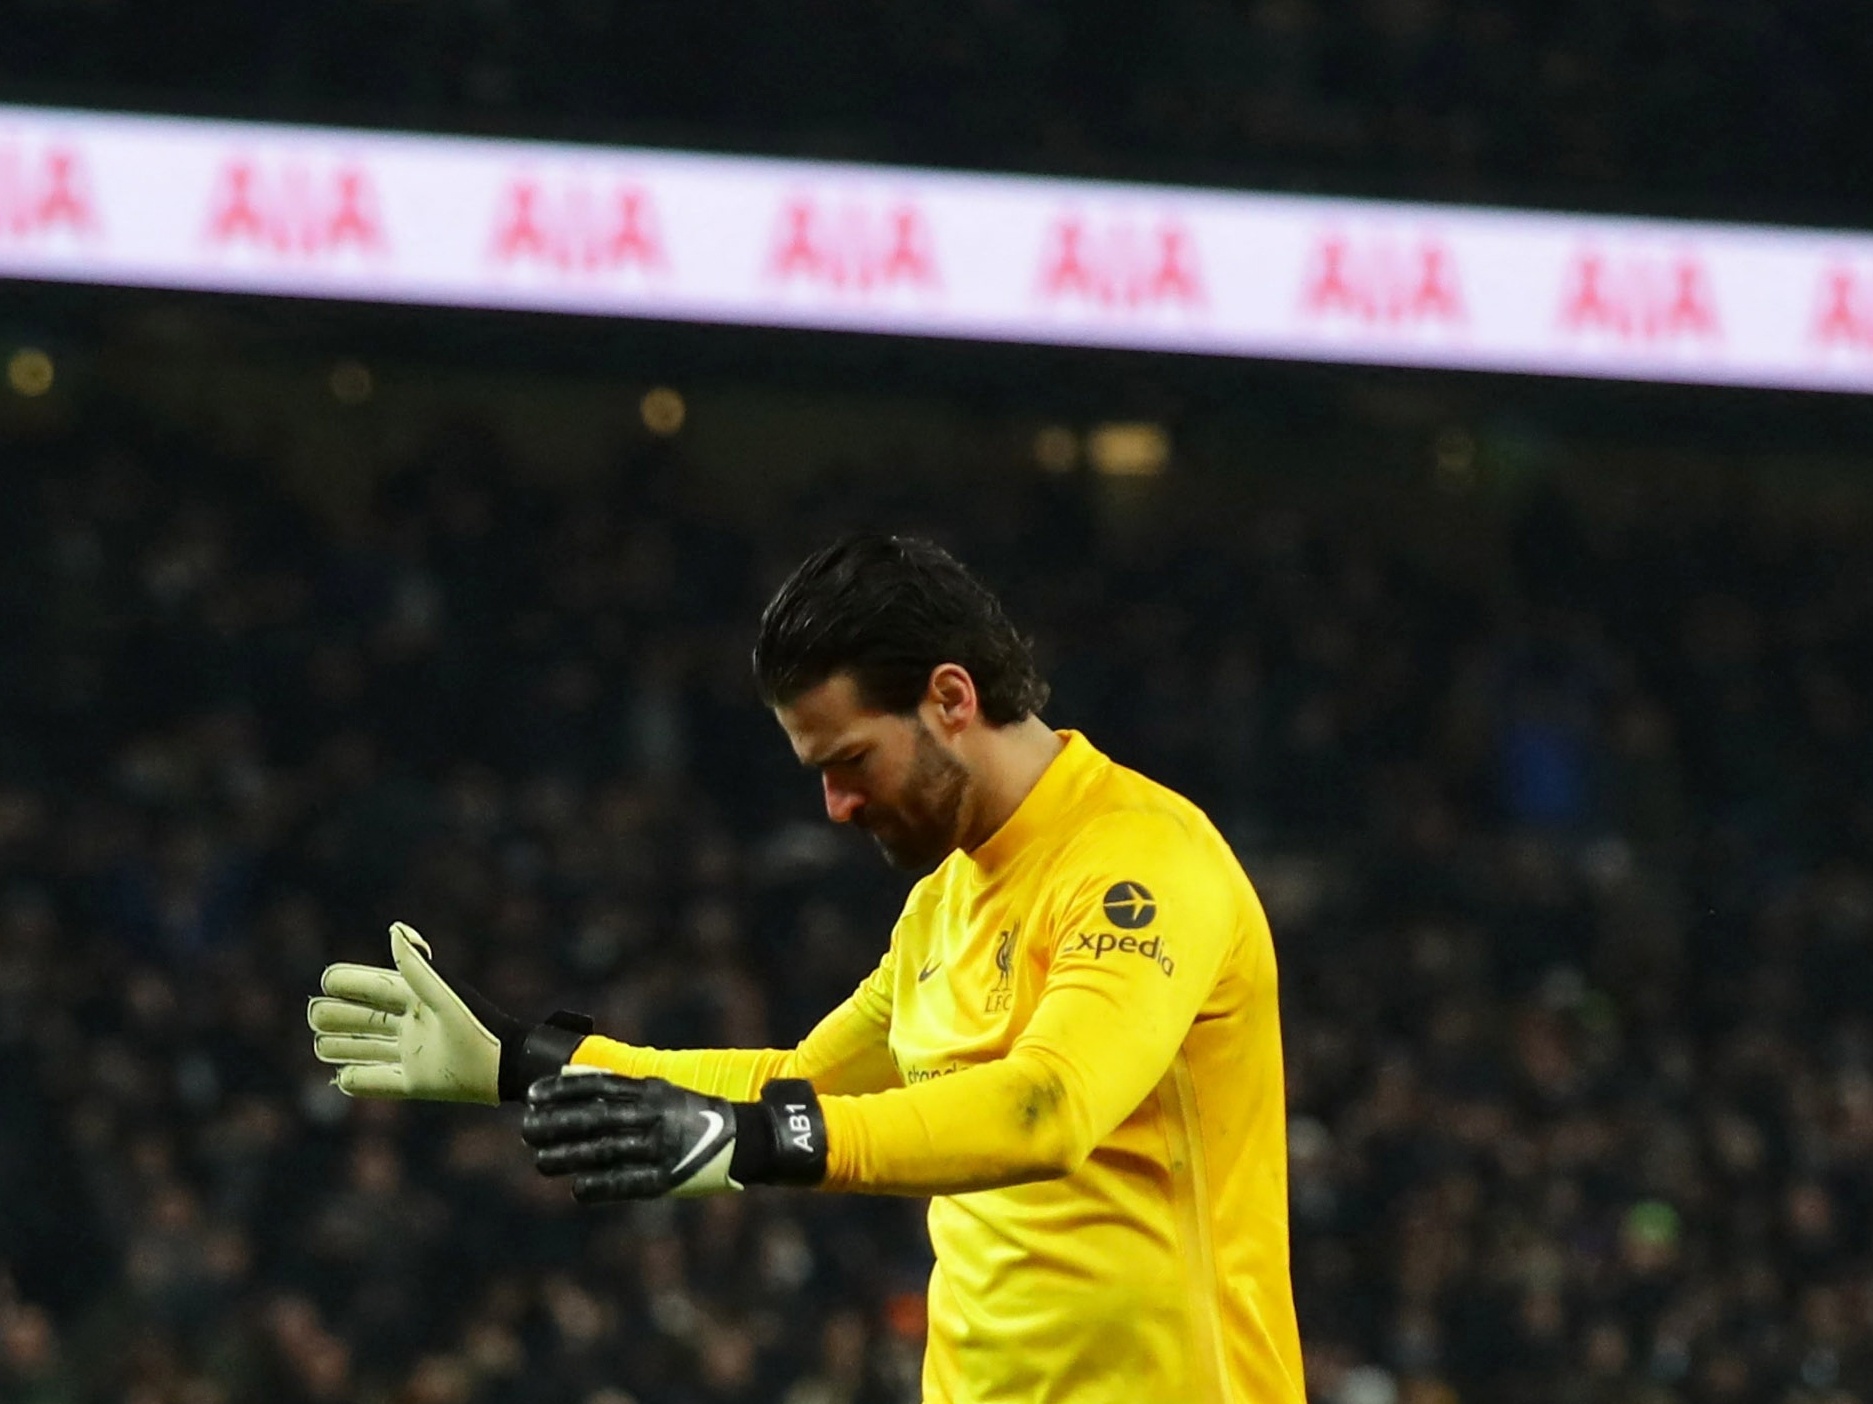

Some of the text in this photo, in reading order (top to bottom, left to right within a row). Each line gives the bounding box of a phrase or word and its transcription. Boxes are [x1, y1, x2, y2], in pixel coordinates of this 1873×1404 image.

[1064, 932, 1175, 978] xpedia
[984, 993, 1013, 1014] LFC
[784, 1103, 815, 1153] AB1
